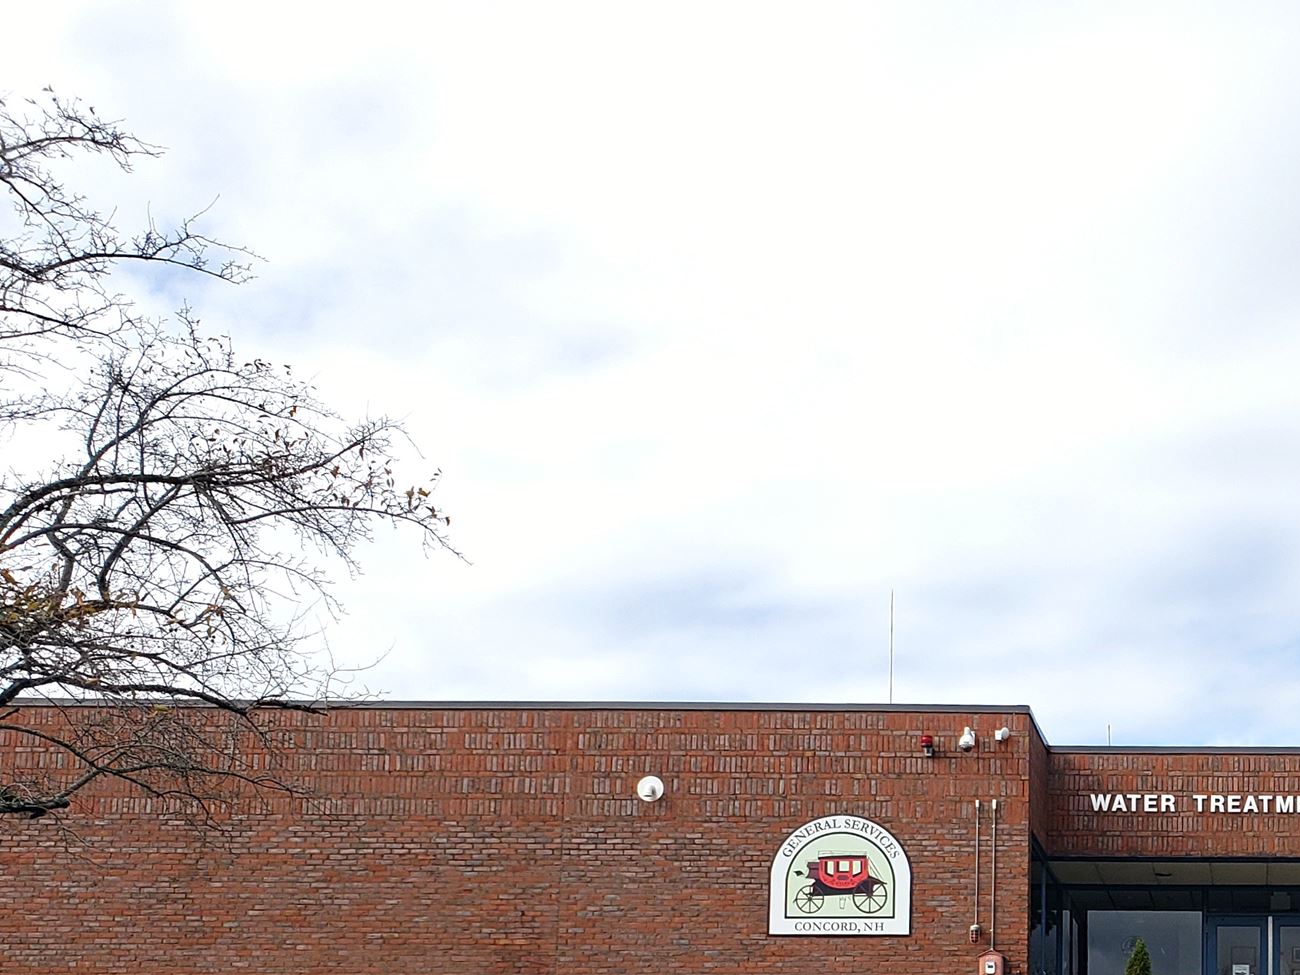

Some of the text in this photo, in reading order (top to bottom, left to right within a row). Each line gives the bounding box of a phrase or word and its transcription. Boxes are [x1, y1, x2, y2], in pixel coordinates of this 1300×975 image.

[1090, 793, 1176, 812] WATER
[782, 818, 901, 859] GENERAL SERVICES
[794, 921, 885, 933] CONCORD, NH
